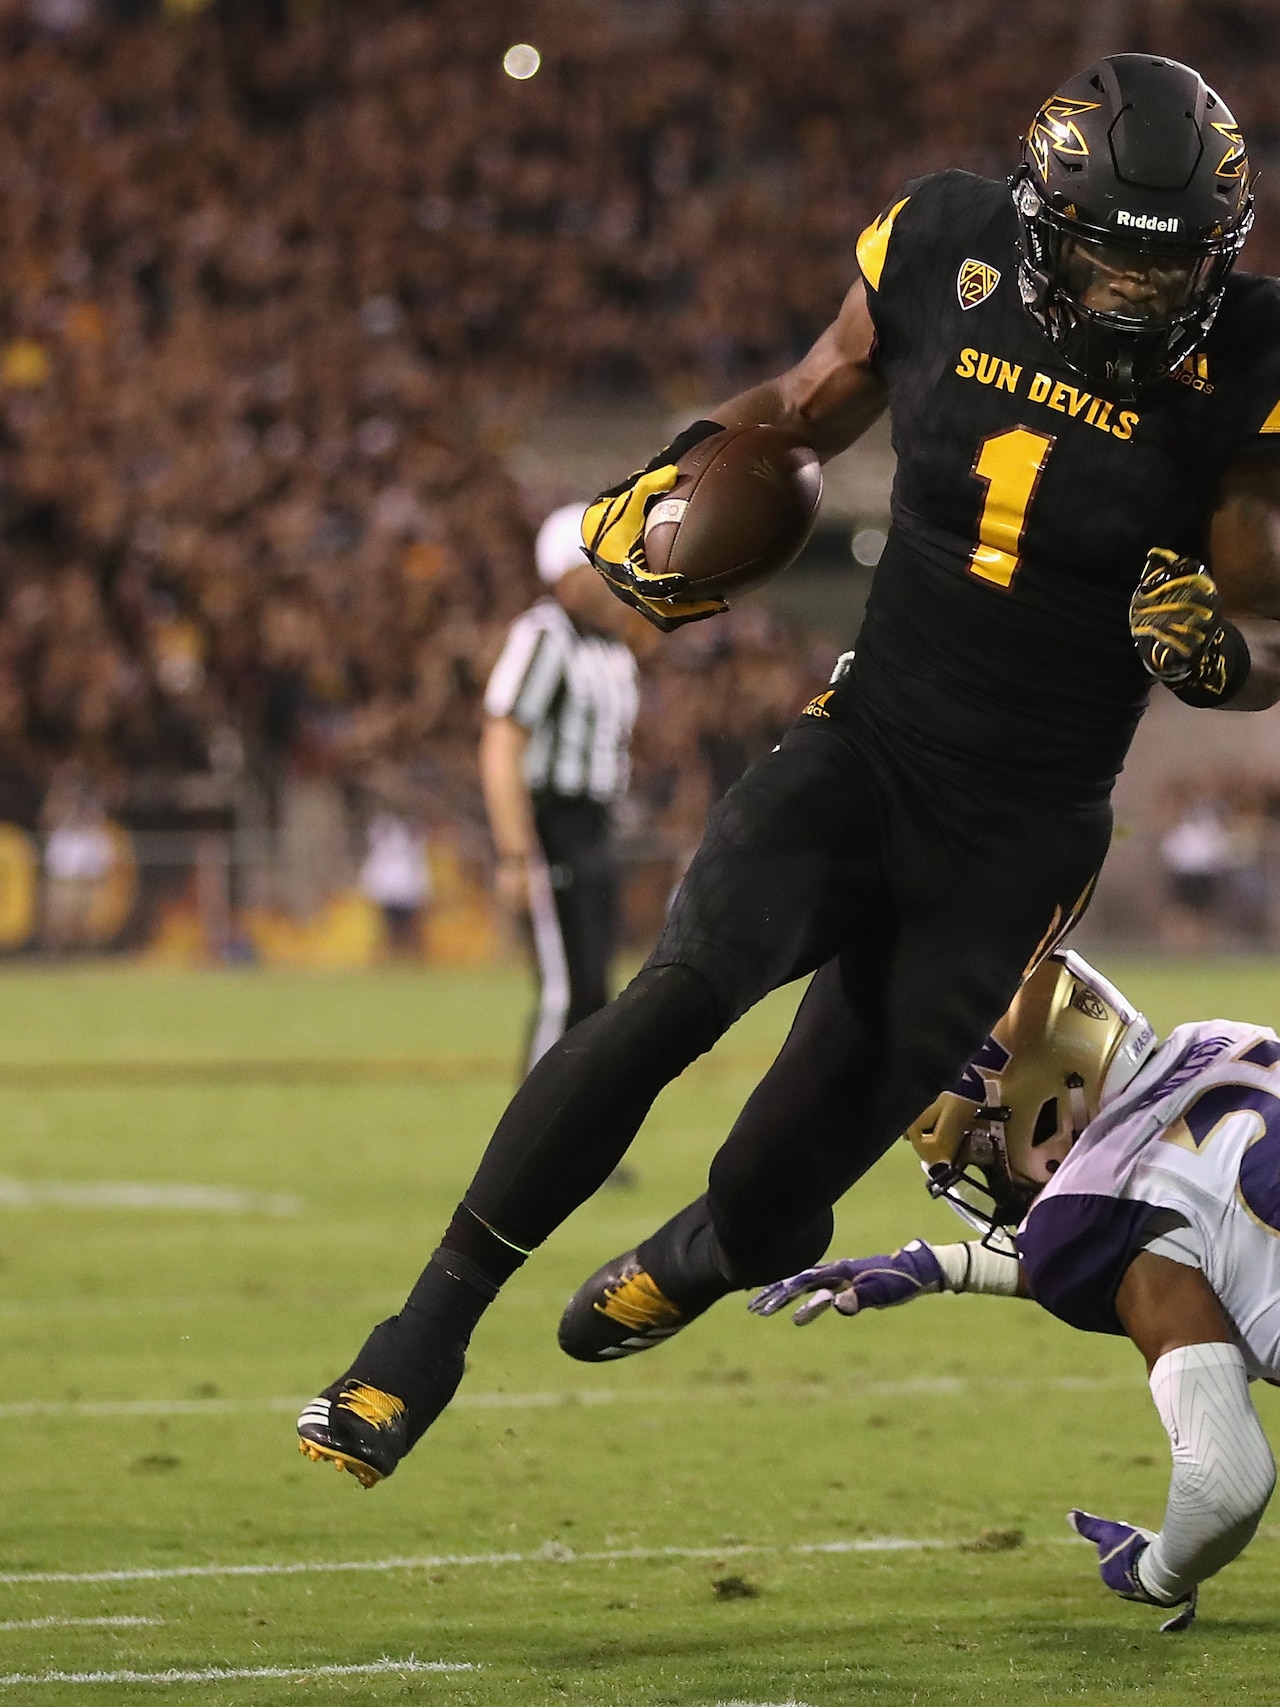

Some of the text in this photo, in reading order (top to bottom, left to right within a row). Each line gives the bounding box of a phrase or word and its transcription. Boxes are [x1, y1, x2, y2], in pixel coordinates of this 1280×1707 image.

[1117, 210, 1179, 233] Riddell
[960, 261, 998, 297] PAC
[961, 281, 983, 302] 12
[955, 347, 1141, 440] SUN DEVILS
[967, 423, 1057, 594] 1
